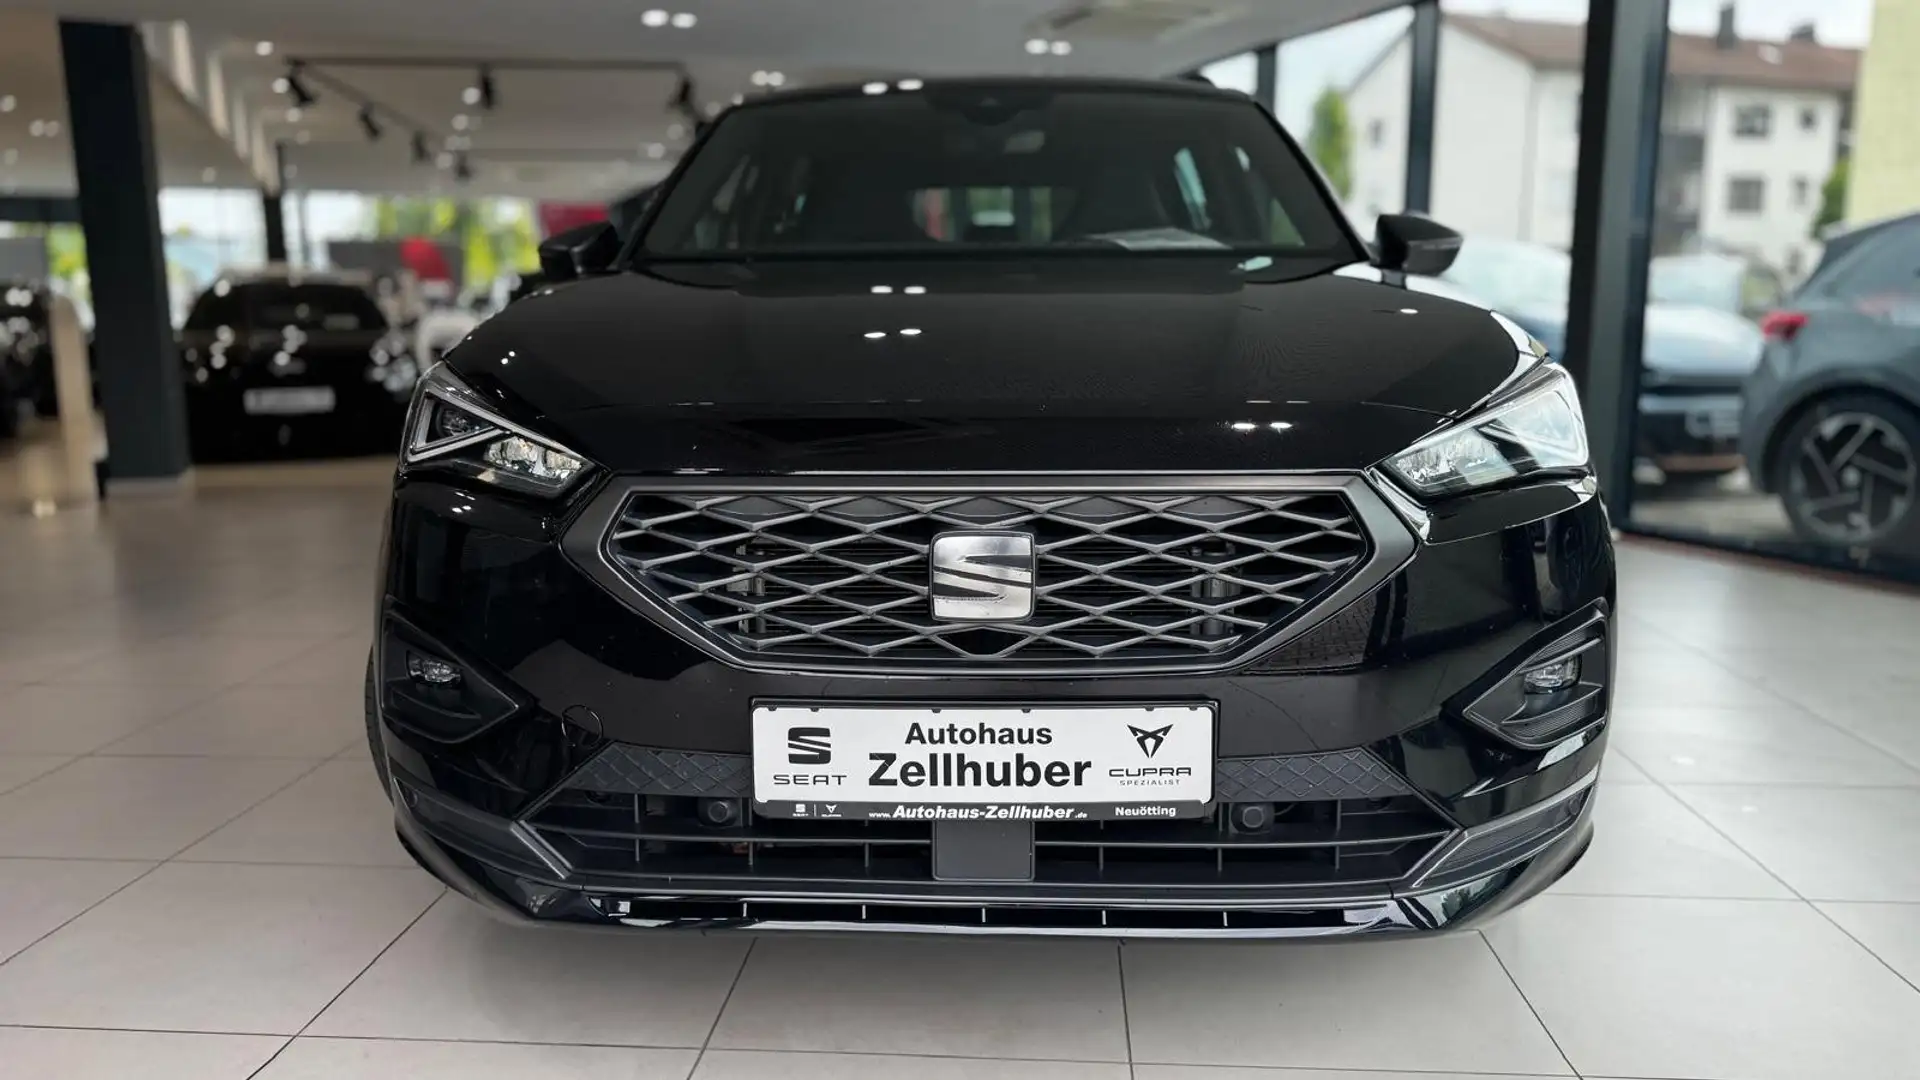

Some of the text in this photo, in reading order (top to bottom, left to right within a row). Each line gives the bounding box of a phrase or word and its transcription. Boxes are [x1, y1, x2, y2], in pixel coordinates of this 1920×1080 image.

[905, 722, 1053, 745] Autohaus
[868, 752, 1092, 787] Zellhuber
[1109, 767, 1192, 777] CUPRA
[773, 774, 847, 786] SEAT
[1115, 805, 1177, 817] Neuötting
